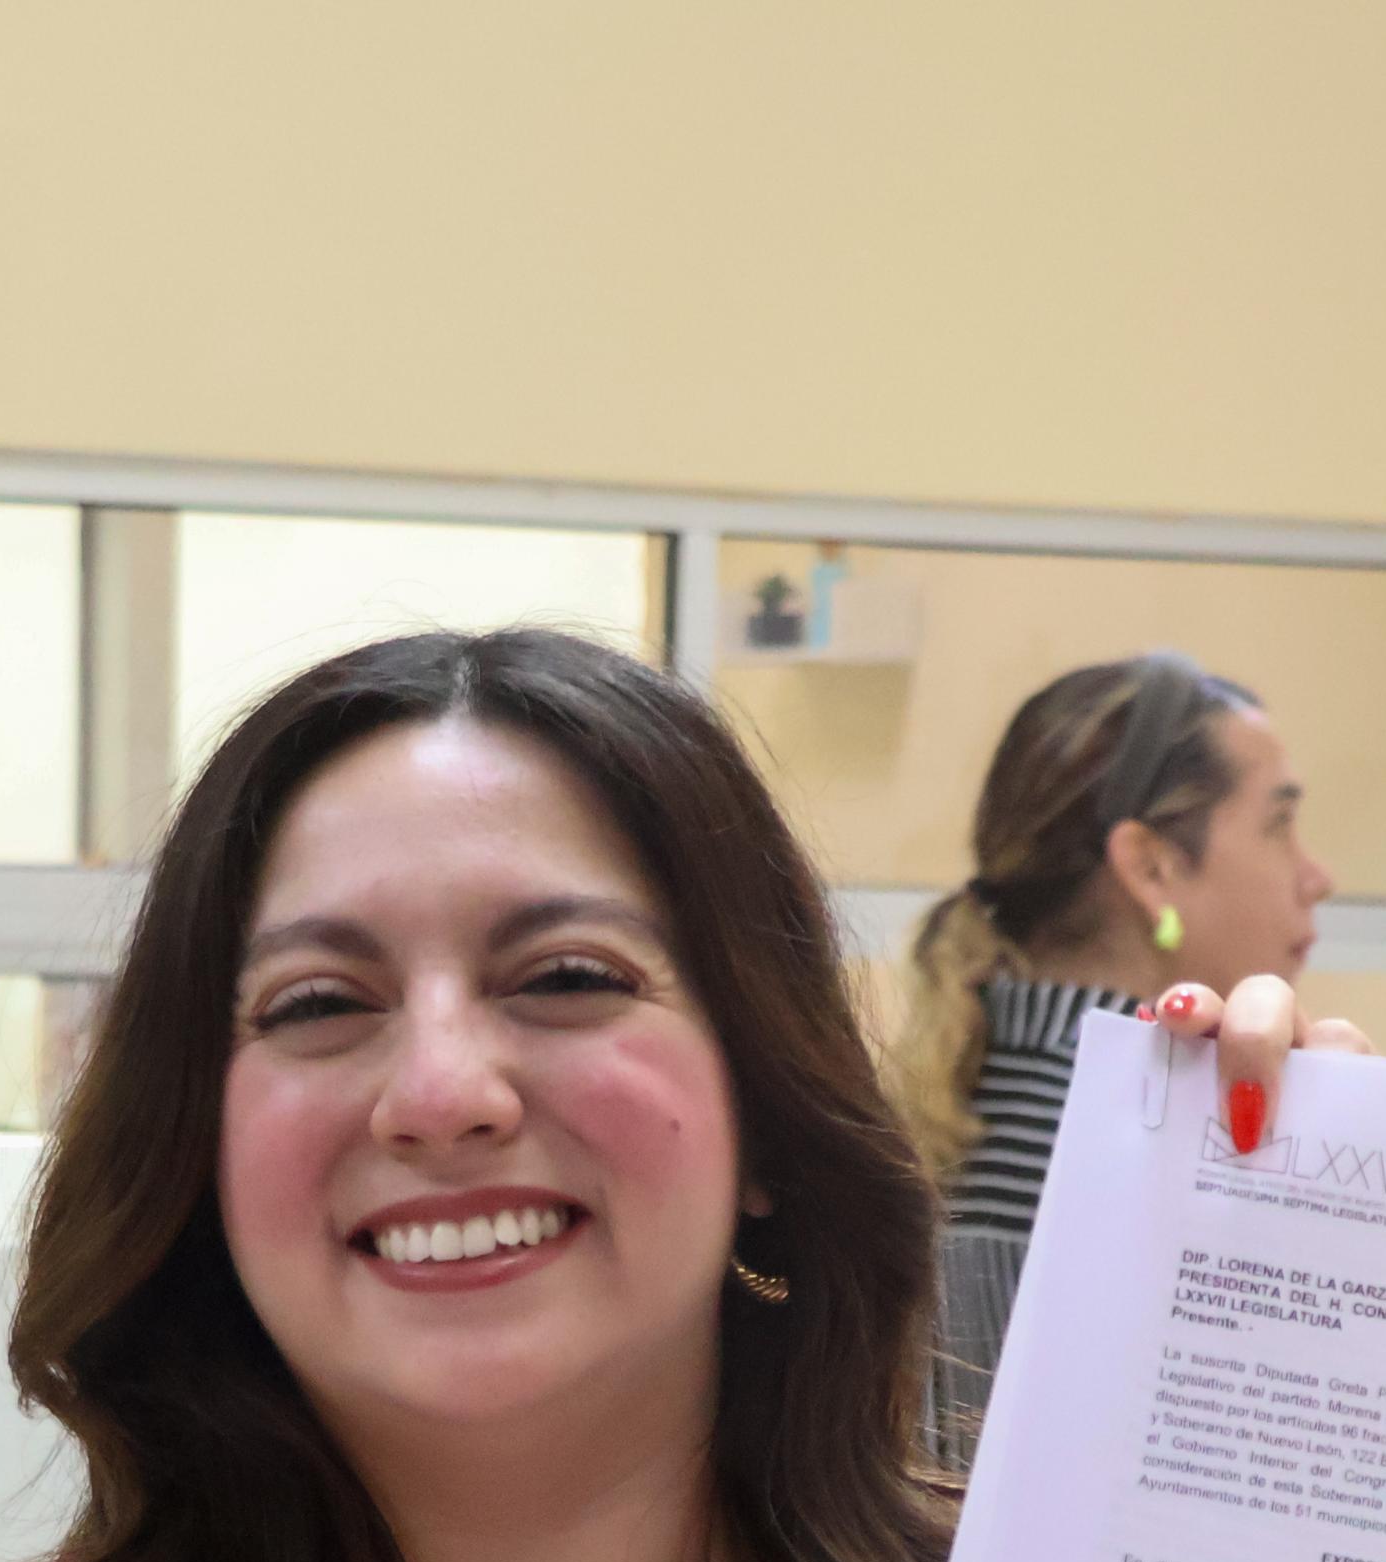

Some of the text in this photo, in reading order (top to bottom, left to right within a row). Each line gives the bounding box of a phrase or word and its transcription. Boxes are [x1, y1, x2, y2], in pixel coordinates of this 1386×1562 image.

[1177, 1268, 1281, 1299] PRESIDENTA
[1288, 1289, 1320, 1308] DEL
[1217, 1257, 1284, 1280] LORENA
[1288, 1270, 1311, 1286] DE
[1315, 1275, 1336, 1291] LA
[1174, 1286, 1342, 1330] LXXVII LEGISLATURA
[1162, 1345, 1181, 1361] La
[1189, 1352, 1246, 1374] suscrita
[1254, 1362, 1319, 1387] Diputada
[1327, 1376, 1368, 1397] Greta
[1158, 1366, 1235, 1393] Legislativo
[1241, 1383, 1265, 1398] del
[1269, 1390, 1320, 1410] partido
[1325, 1398, 1381, 1421] Morena
[1145, 1432, 1160, 1445] el
[1171, 1435, 1237, 1460] Gobierno
[1248, 1449, 1298, 1471] Interior
[1309, 1463, 1332, 1478] del
[1247, 1473, 1266, 1488] de
[1272, 1479, 1303, 1495] esta
